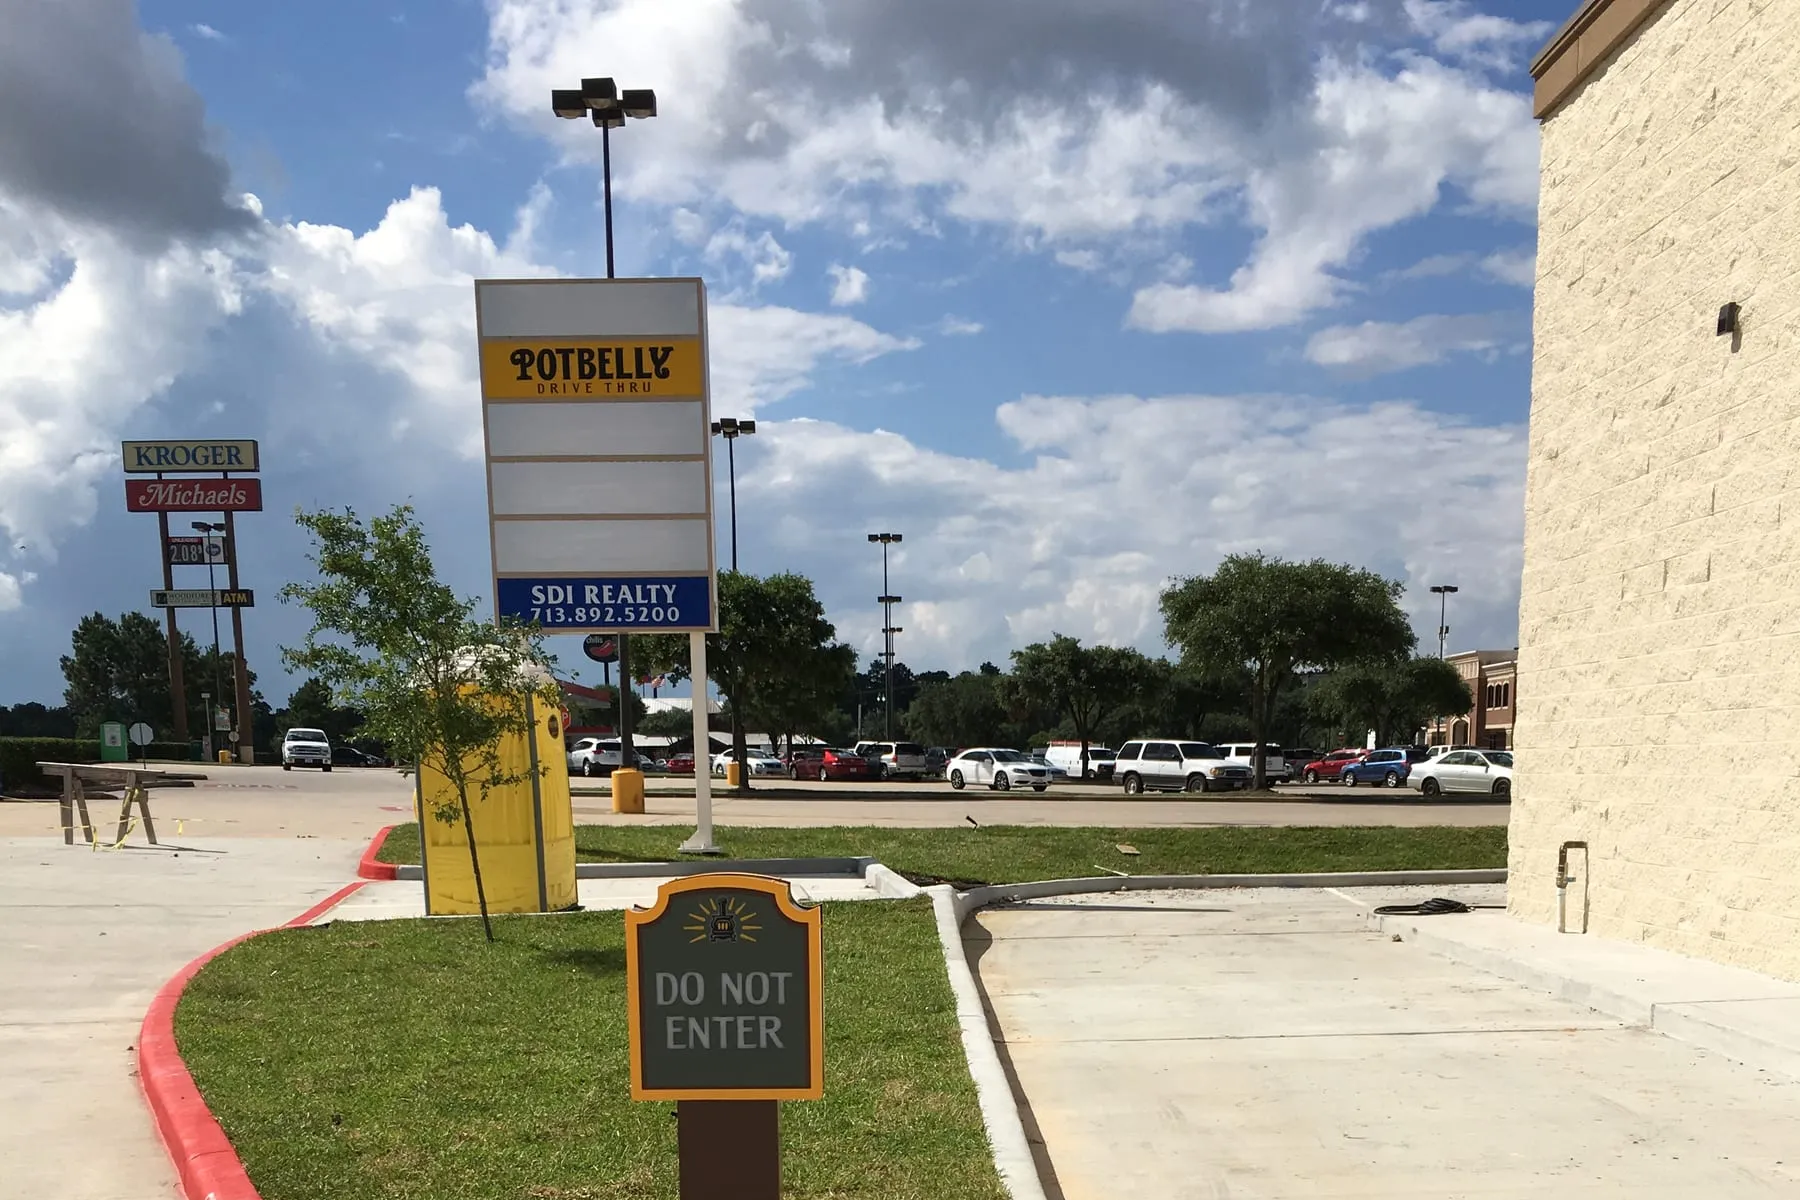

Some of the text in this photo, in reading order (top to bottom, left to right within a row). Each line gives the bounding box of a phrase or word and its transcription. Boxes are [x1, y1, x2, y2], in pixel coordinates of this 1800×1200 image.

[510, 347, 674, 380] POTBELLY
[537, 381, 652, 394] DRIVE THRU
[133, 445, 244, 466] KROGER
[138, 483, 247, 506] Michaels
[222, 592, 248, 604] ATM
[531, 584, 677, 604] SDI REALTY
[530, 607, 680, 623] 713.892.5200
[655, 971, 793, 1006] DO NOT
[666, 1015, 786, 1050] ENTER
